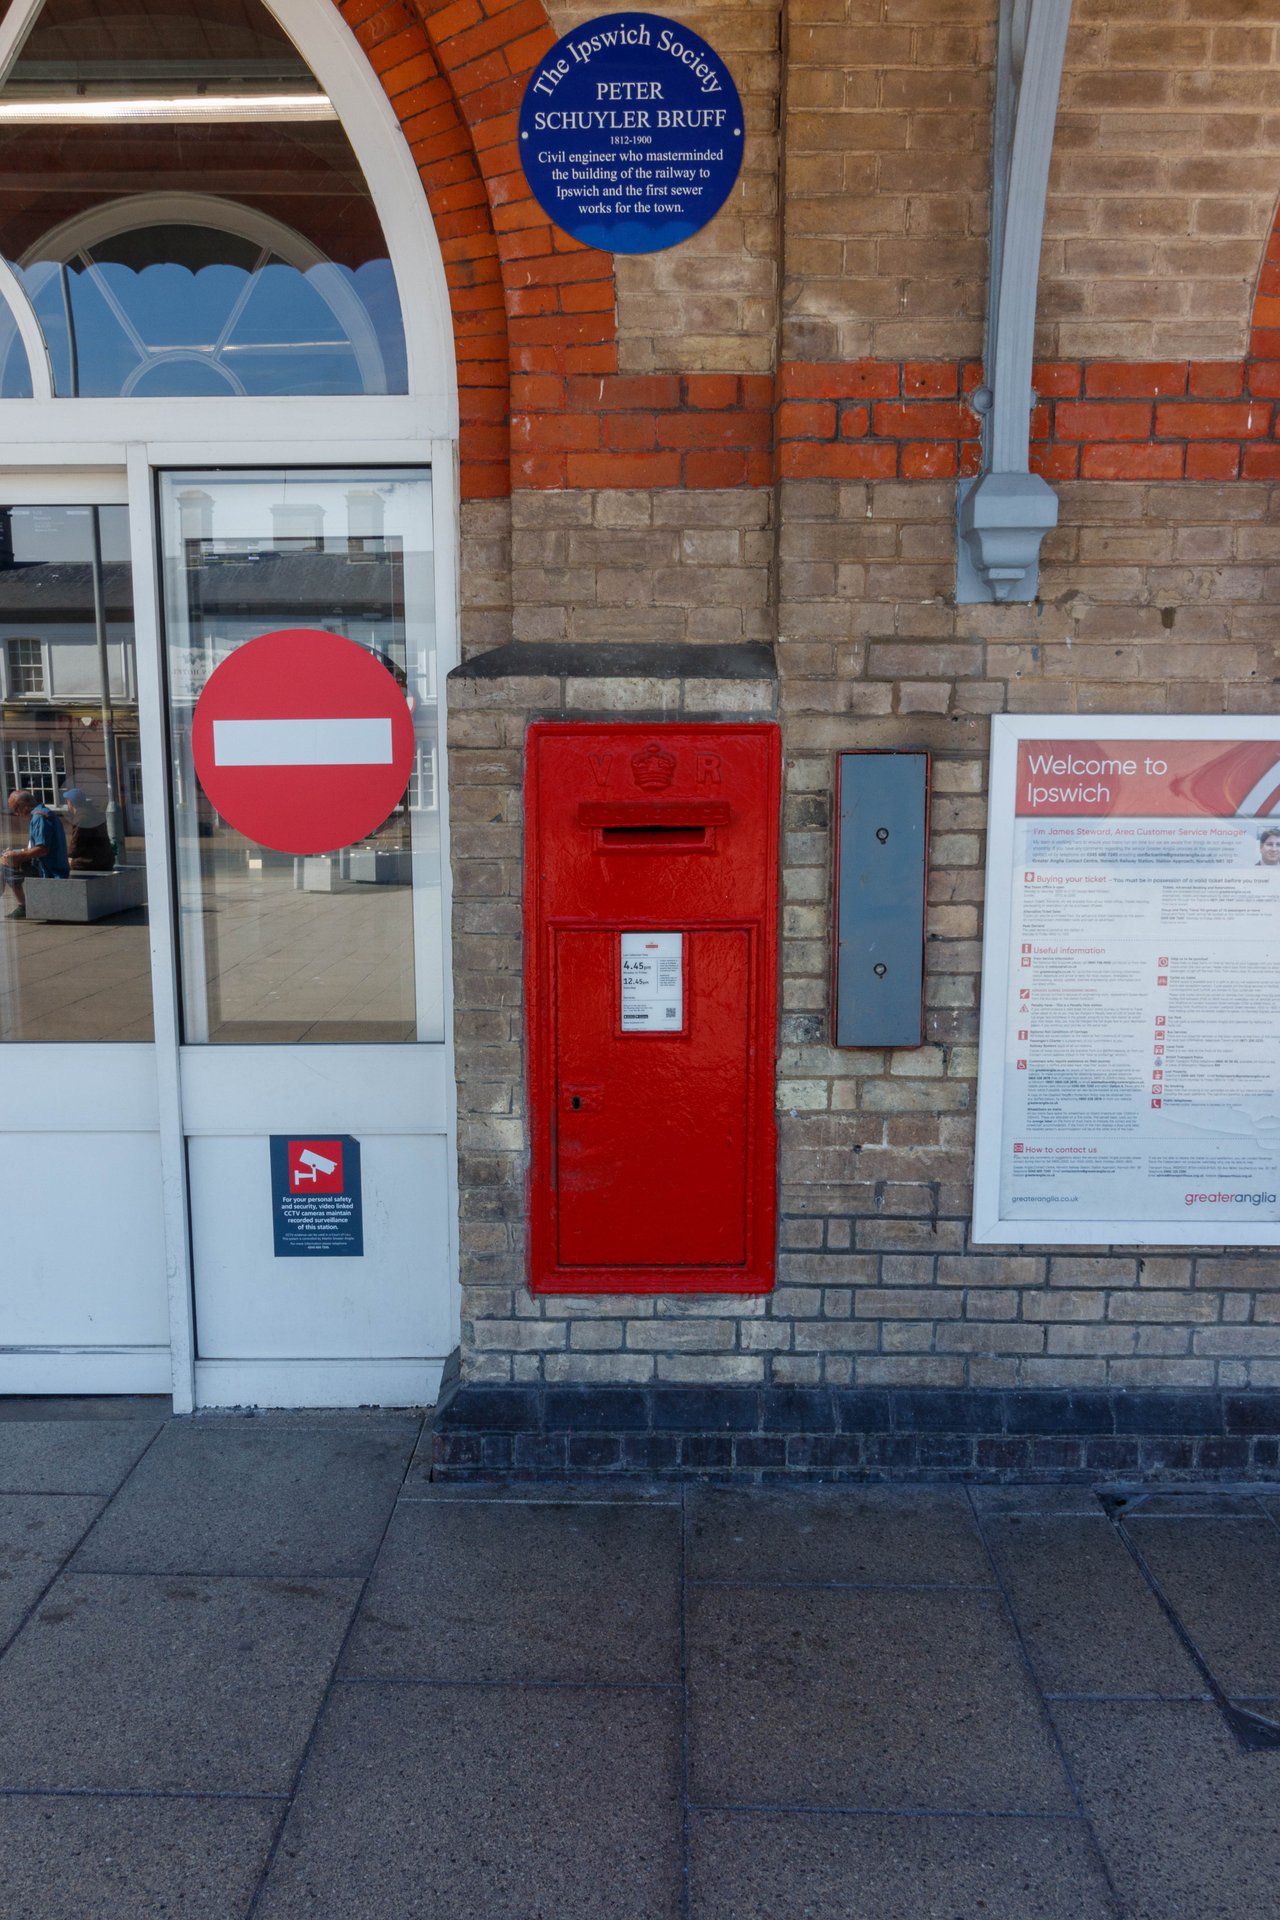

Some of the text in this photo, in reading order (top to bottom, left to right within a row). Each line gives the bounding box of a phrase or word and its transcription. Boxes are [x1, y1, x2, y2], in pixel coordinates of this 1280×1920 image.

[533, 23, 722, 97] The Ipswich Society
[596, 82, 664, 100] PETER
[534, 109, 727, 130] SCHUYLER BRUFF
[610, 136, 652, 145] 1812-1900
[538, 149, 724, 164] Civil engineer who masterminded
[552, 167, 710, 182] the building of the railway to
[556, 184, 704, 200] Ipswich and the first sewer
[578, 202, 684, 214] works for the town.
[588, 752, 722, 786] V R
[1028, 755, 1168, 776] Welcome to
[1028, 783, 1110, 807] Ipswich
[1034, 828, 1247, 838] I'm James Steward, Area Customer Service Manager
[1036, 876, 1062, 884] Buying
[1012, 1195, 1079, 1204] greateranglia.co.uk
[1185, 1192, 1276, 1206] greateranglia
